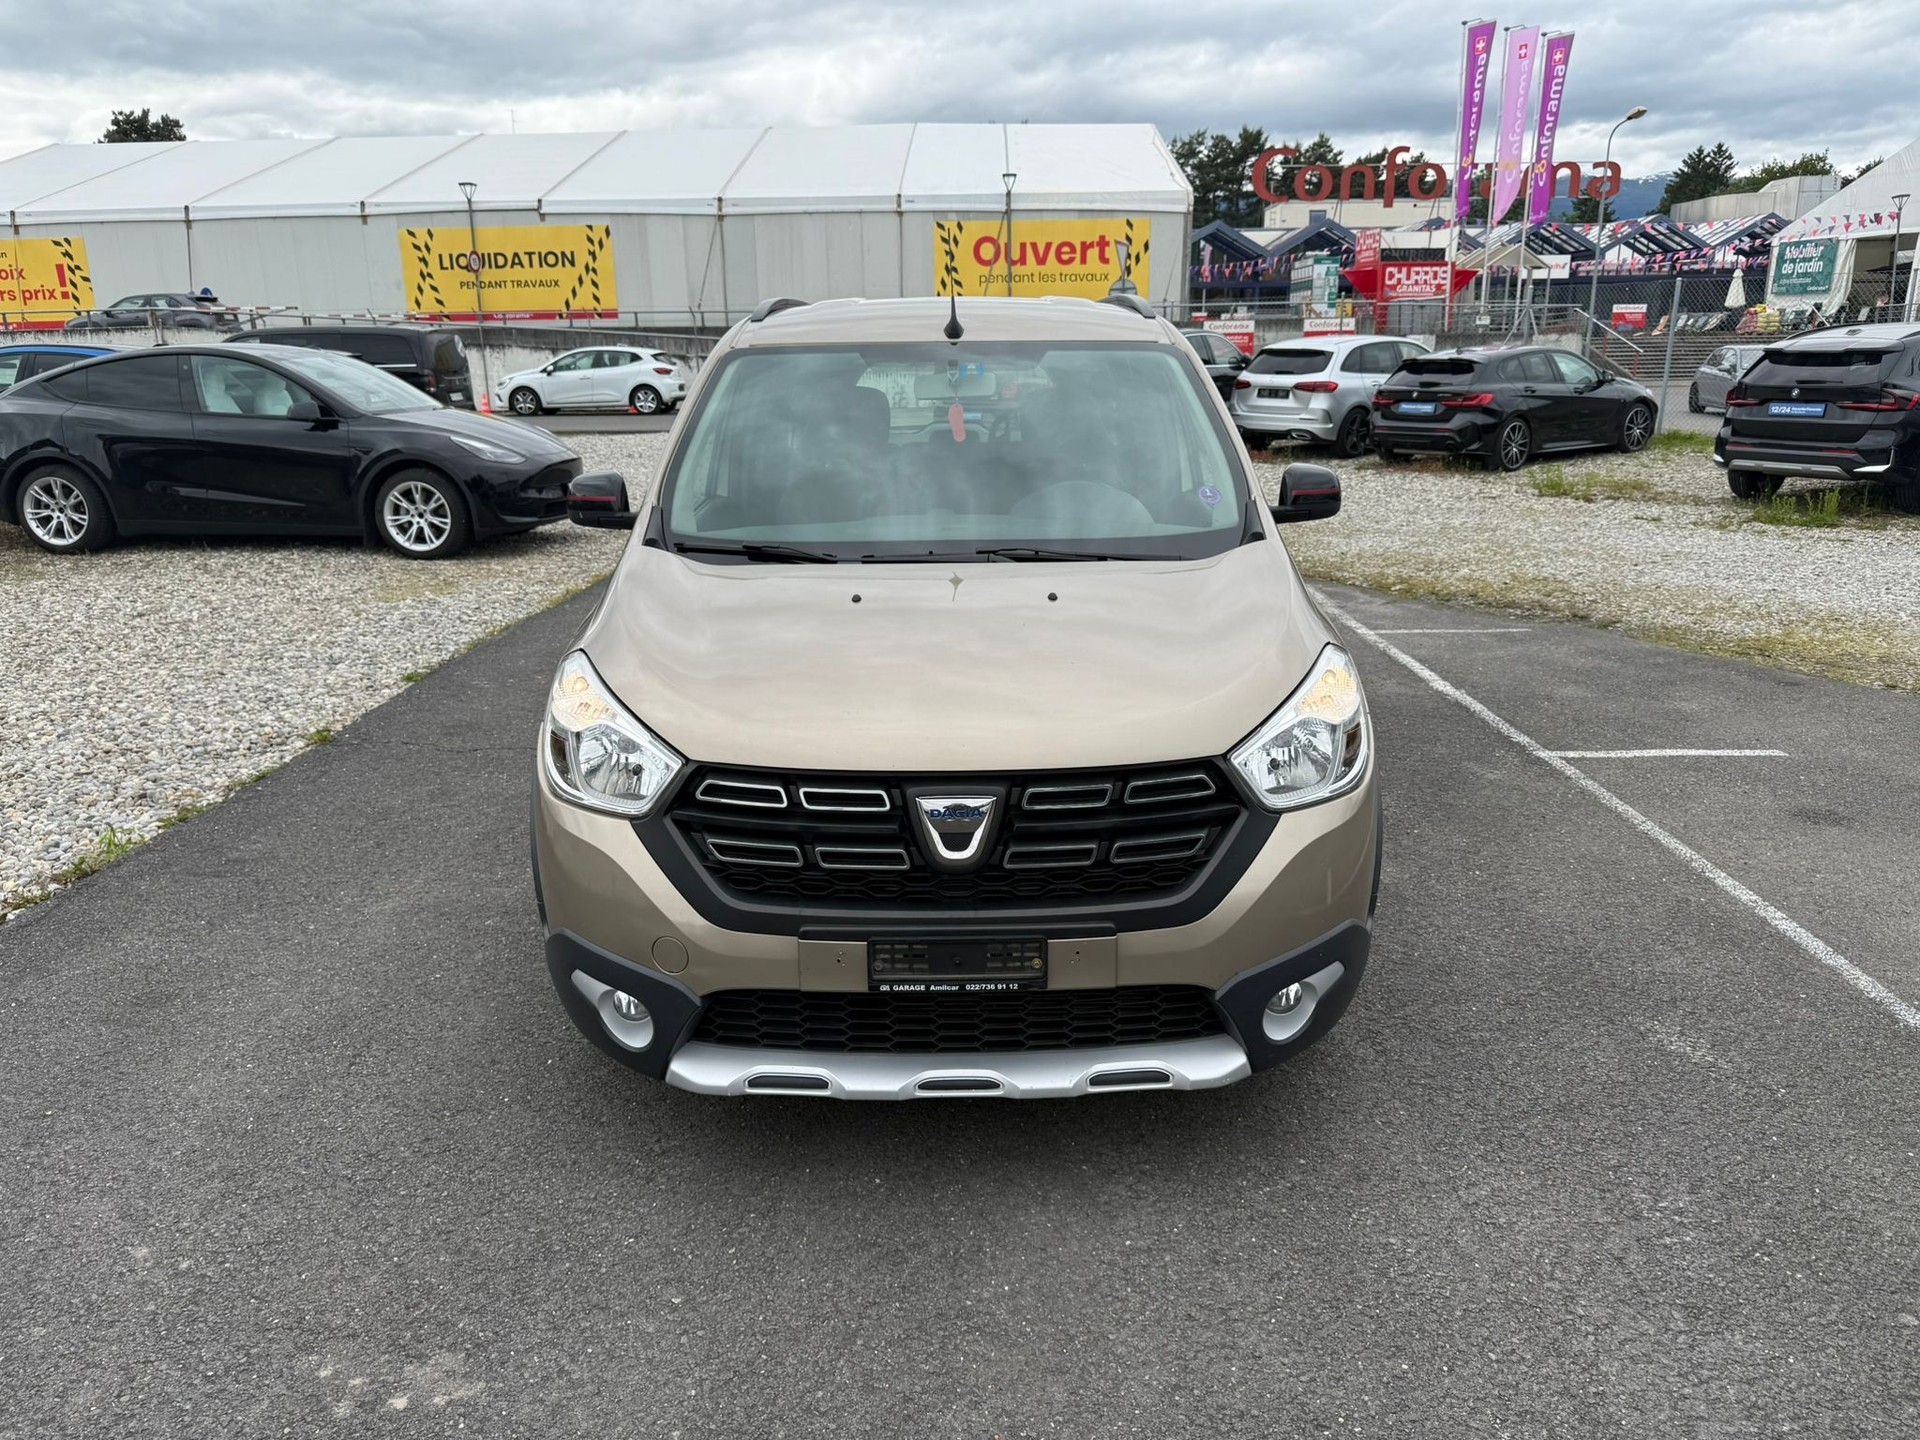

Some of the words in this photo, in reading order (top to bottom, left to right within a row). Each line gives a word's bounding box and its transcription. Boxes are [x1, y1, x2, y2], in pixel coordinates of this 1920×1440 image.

[1251, 145, 1622, 208] Confoma
[973, 234, 1111, 268] Ouvert
[1781, 261, 1794, 274] de
[1793, 258, 1824, 278] jardin
[1038, 271, 1056, 283] les
[1059, 271, 1110, 283] travaux
[1385, 266, 1448, 285] CHURROS
[459, 280, 507, 290] PENDANT
[511, 279, 560, 289] TRAVAUX
[1396, 284, 1437, 293] GRANITAS
[929, 808, 983, 818] DACIA
[965, 983, 996, 991] 022/736
